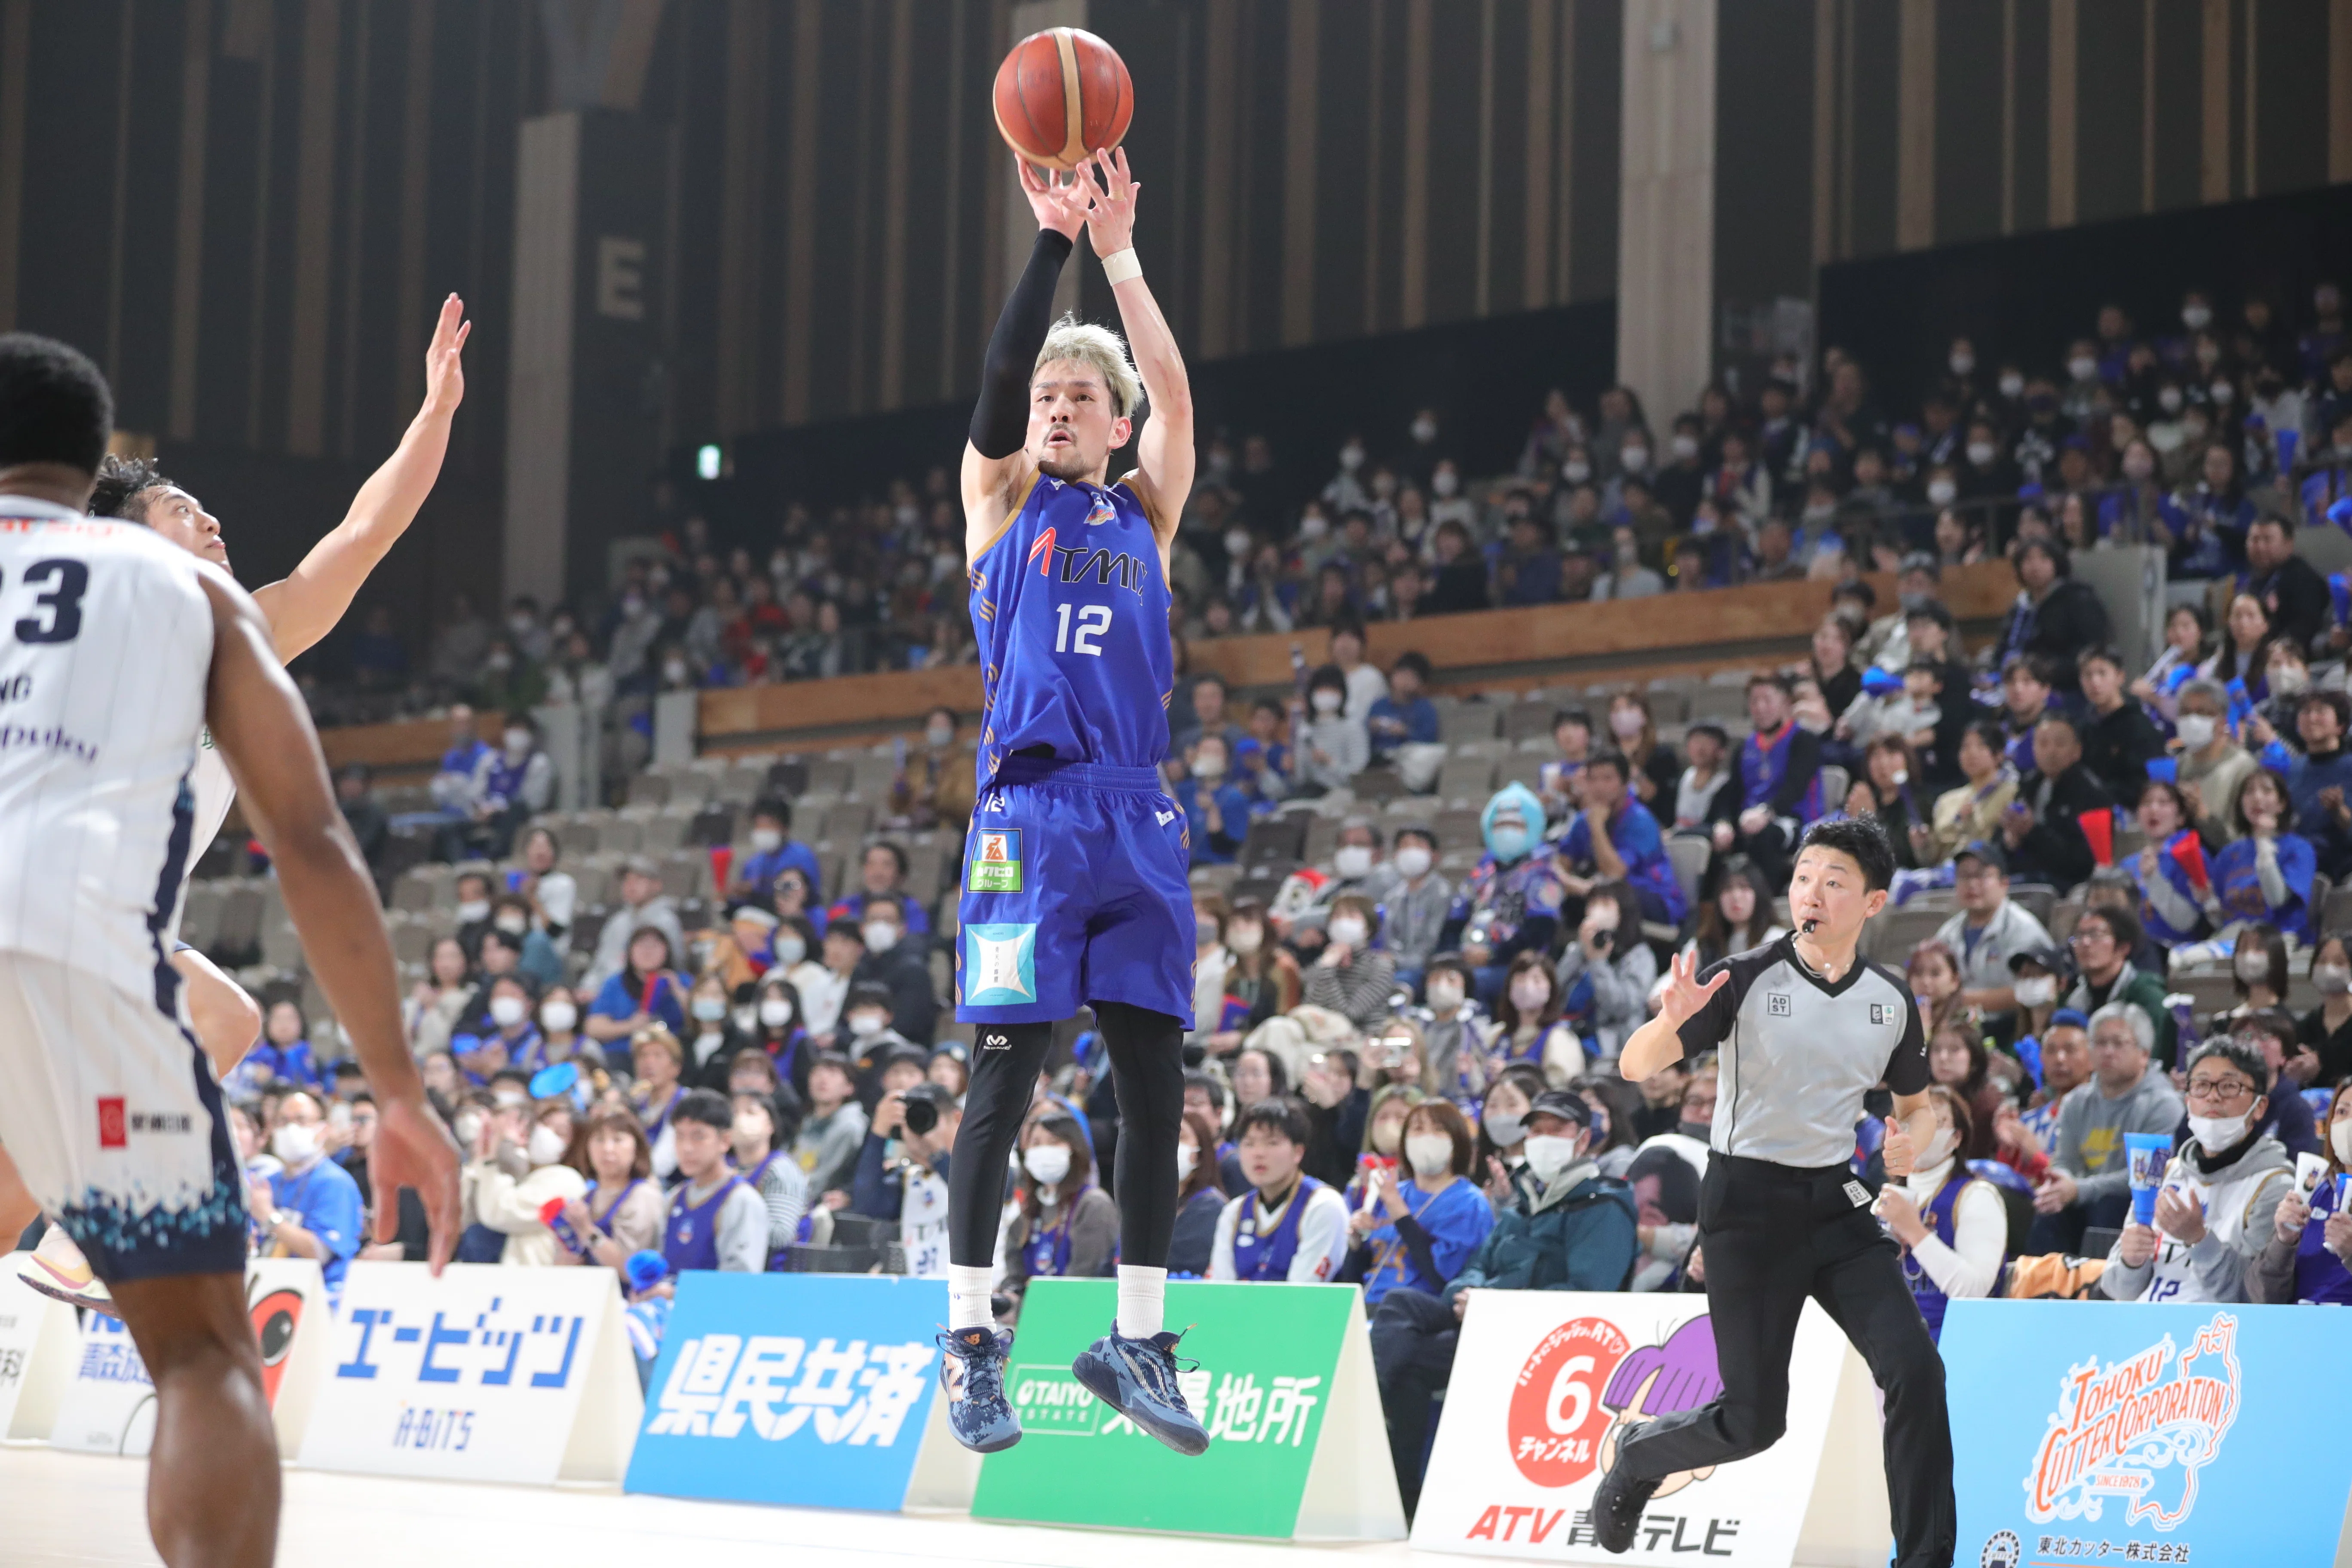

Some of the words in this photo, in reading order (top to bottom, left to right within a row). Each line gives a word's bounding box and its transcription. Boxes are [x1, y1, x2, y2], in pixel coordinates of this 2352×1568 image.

[599, 236, 644, 321] E
[0, 557, 89, 644] 3
[1056, 603, 1112, 656] 12
[984, 793, 1005, 812] 12
[977, 866, 1014, 878] カクヒロ
[1772, 996, 1786, 1005] AD
[1772, 1004, 1786, 1013] ST
[336, 1296, 584, 1389] エービッツ
[646, 1333, 937, 1447] 県民共済
[1545, 1355, 1596, 1435] 6
[2071, 1349, 2163, 1433] TOHOKU
[1516, 1436, 1591, 1464] チャンネル
[2036, 1412, 2116, 1512] CUTTER
[2115, 1378, 2225, 1455] CORPORATION
[1466, 1505, 1566, 1544] ATV
[1567, 1509, 1740, 1556] 青テレビ
[2037, 1536, 2190, 1563] 東北カッター株式会社
